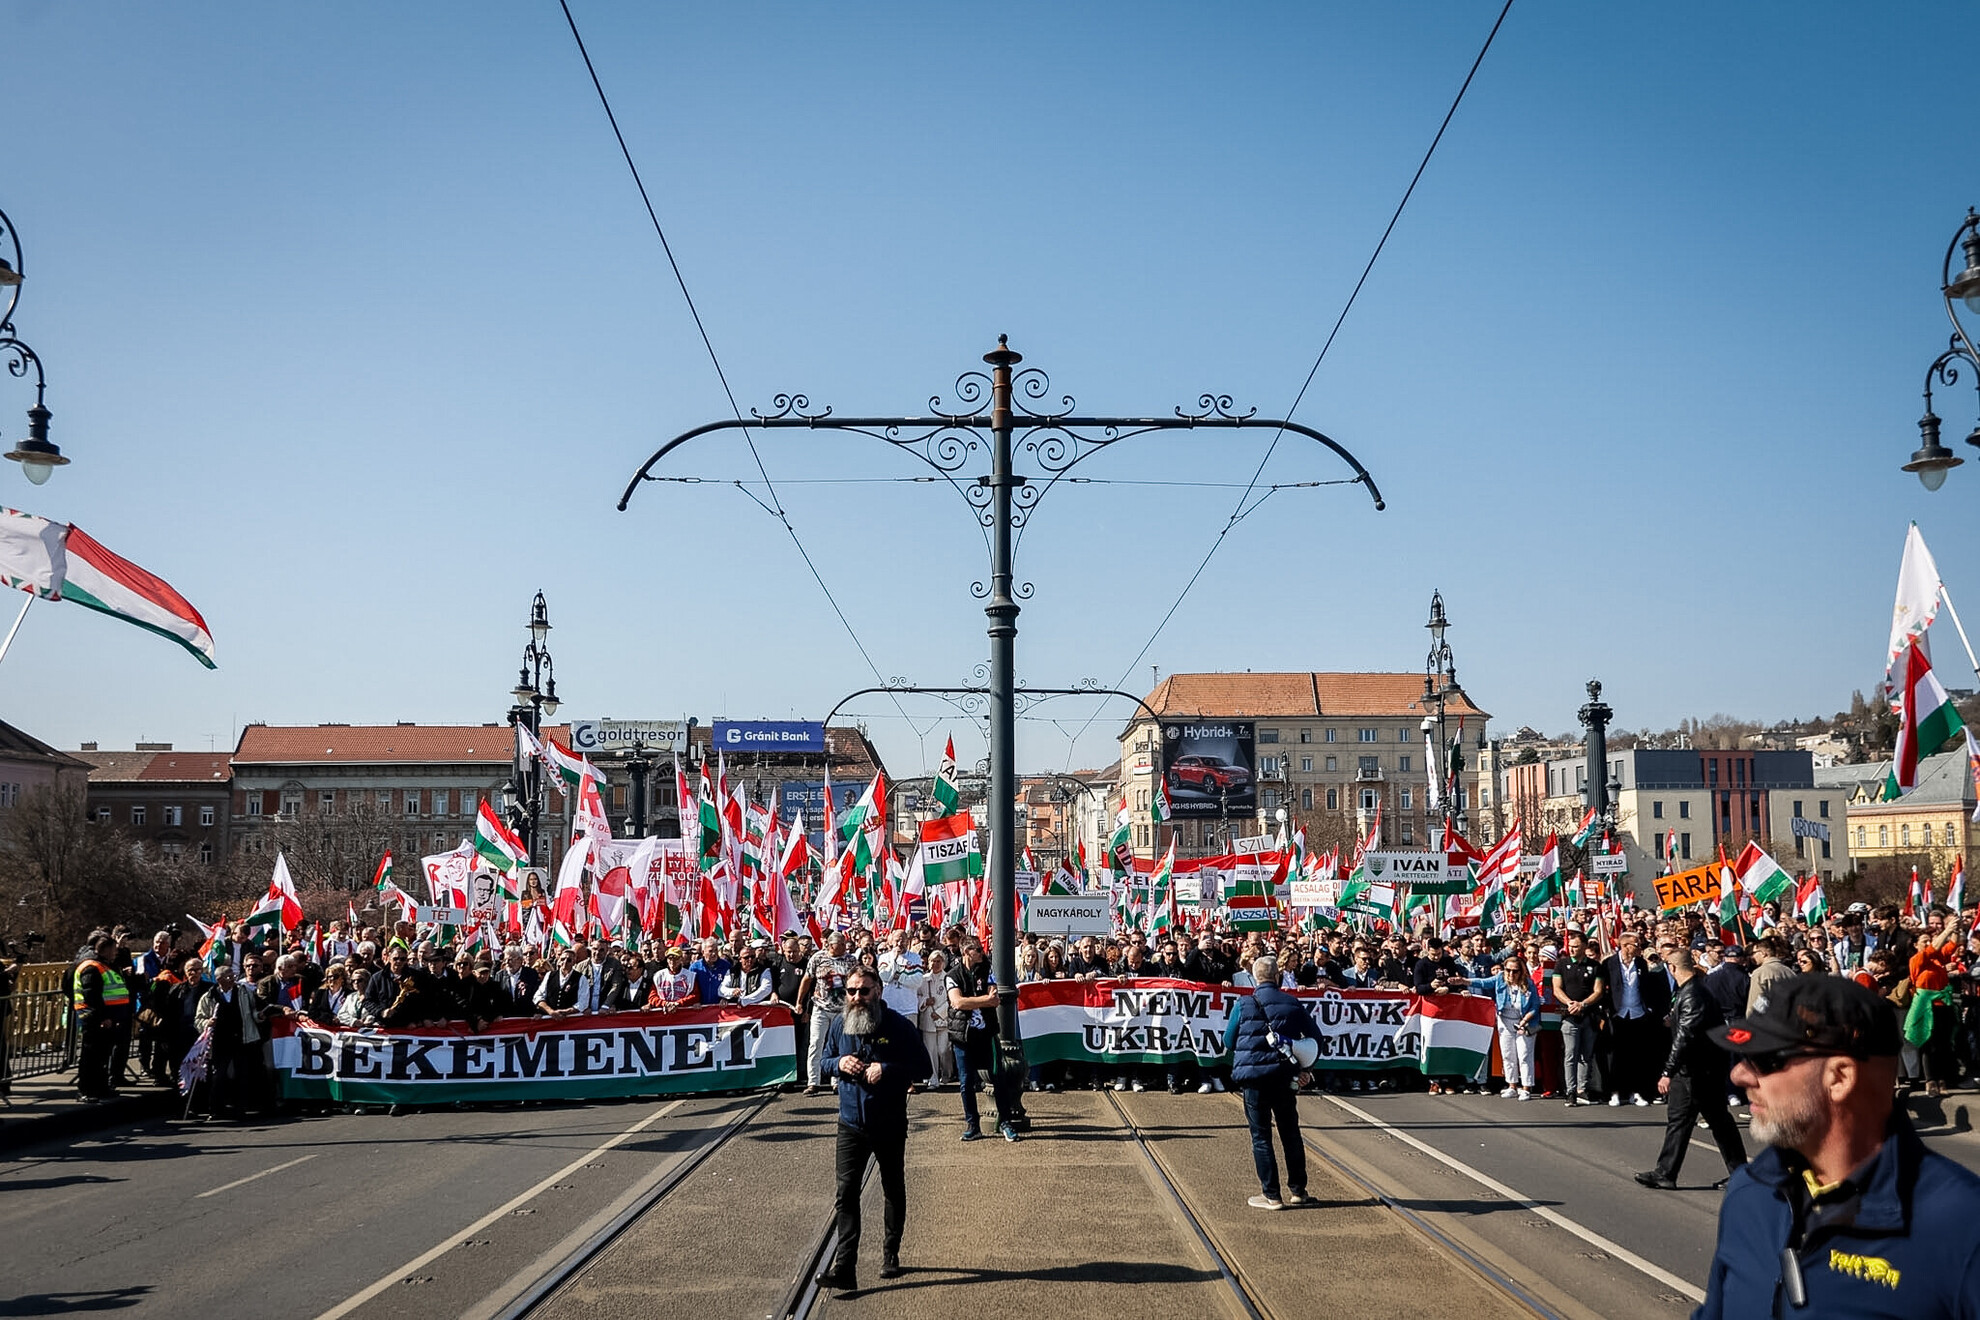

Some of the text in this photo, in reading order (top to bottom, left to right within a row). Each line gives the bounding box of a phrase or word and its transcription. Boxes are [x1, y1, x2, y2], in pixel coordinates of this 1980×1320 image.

[597, 727, 685, 745] goldtresor
[744, 729, 780, 742] Gránit
[782, 730, 810, 742] Bank
[1184, 725, 1233, 740] Hybrid+
[786, 791, 816, 801] ERSE
[1238, 839, 1271, 854] SZIL
[1393, 857, 1439, 872] IVÁN
[1293, 884, 1330, 893] ACSALAG
[1655, 866, 1738, 906] FARÁD
[1036, 907, 1102, 918] NAGYKÁROLY
[1115, 991, 1210, 1018] NEM
[1082, 1020, 1226, 1055] UKRÁN
[296, 1022, 760, 1080] BÉKEMENET
